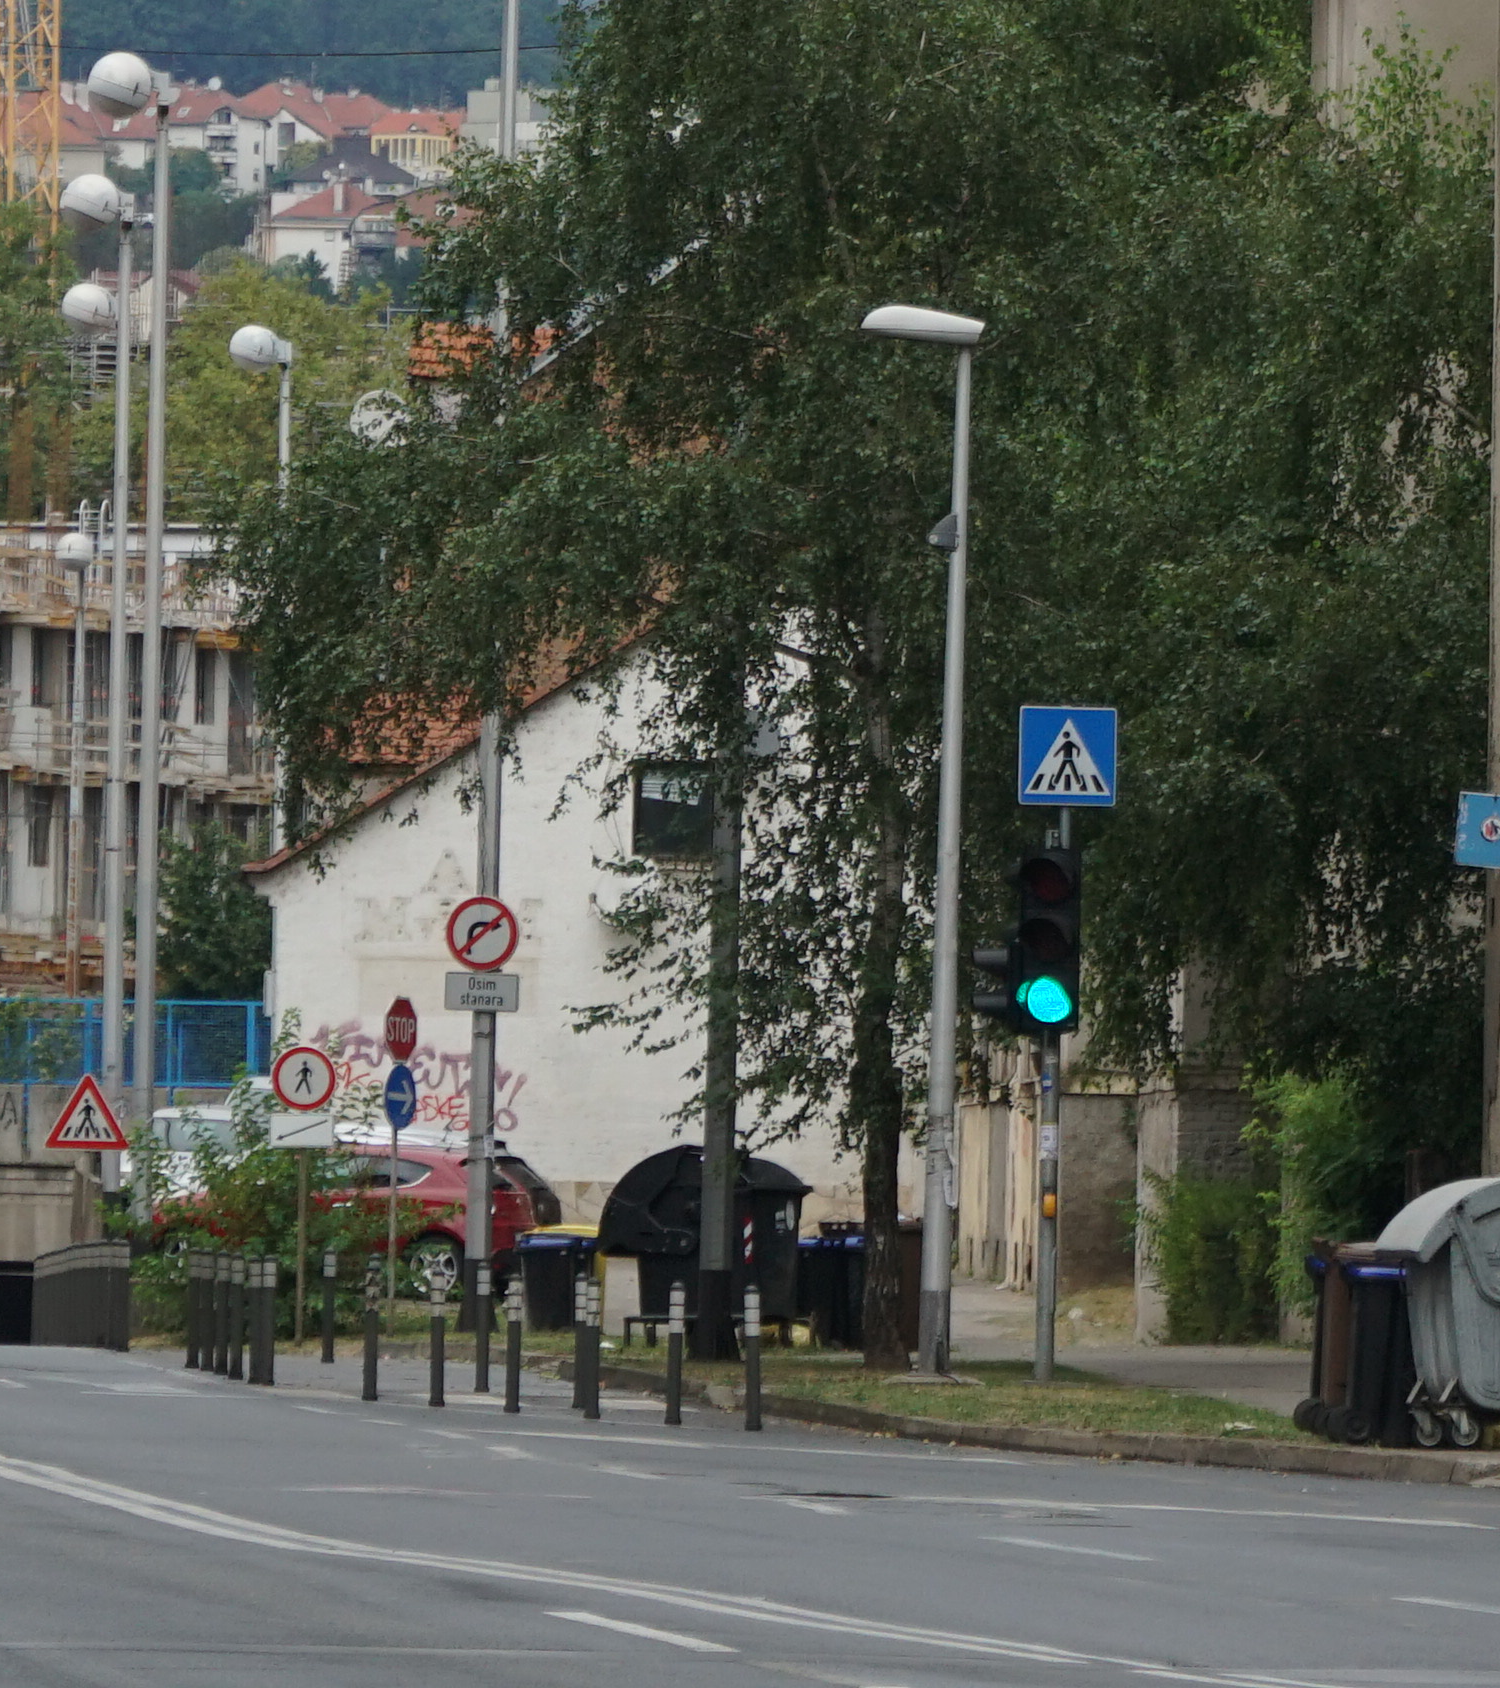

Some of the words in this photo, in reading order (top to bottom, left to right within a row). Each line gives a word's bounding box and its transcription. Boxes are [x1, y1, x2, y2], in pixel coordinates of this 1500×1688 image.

[468, 977, 496, 991] Osim
[460, 992, 504, 1007] stanara
[386, 1016, 416, 1044] STOP
